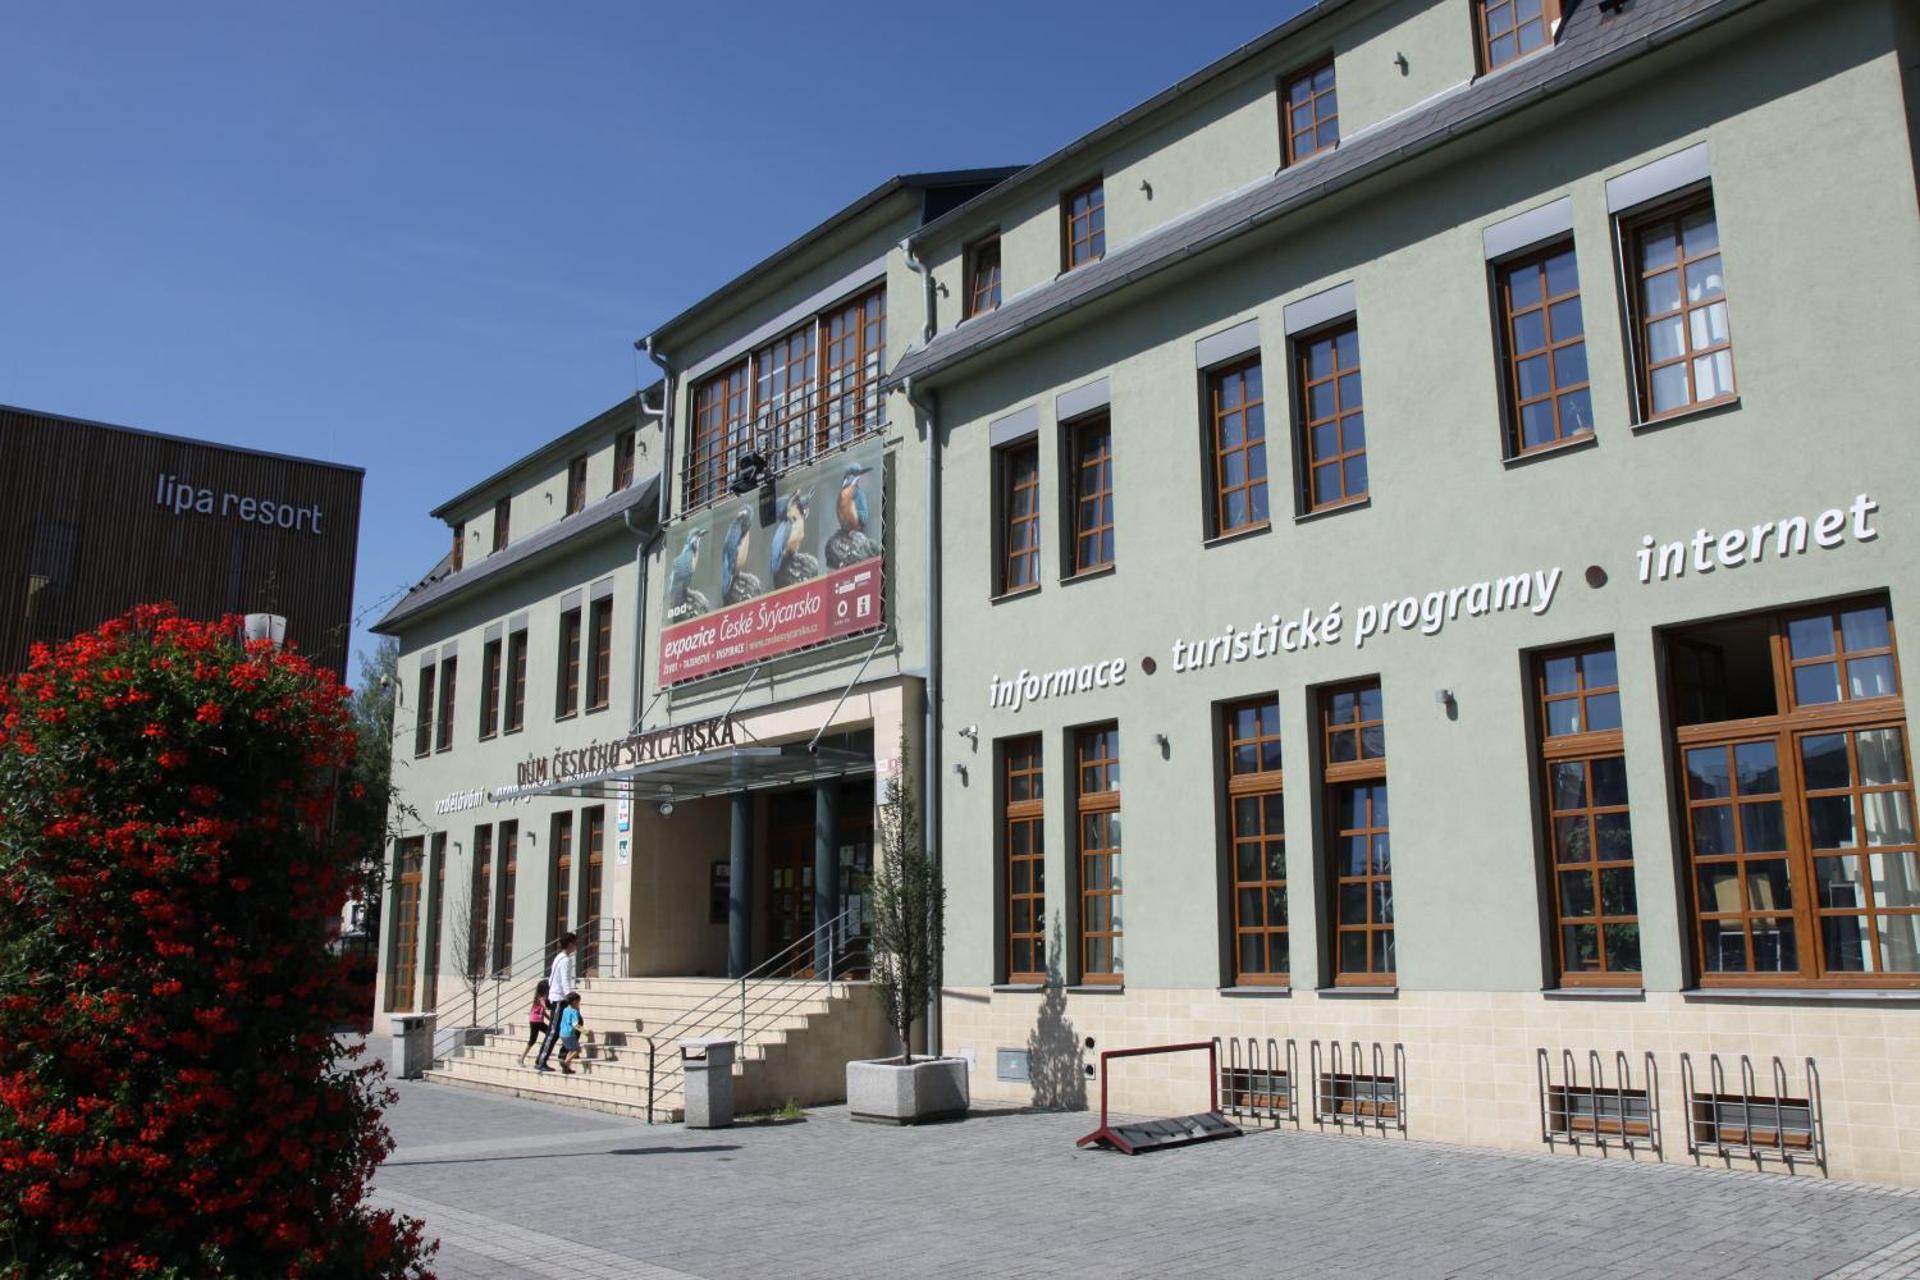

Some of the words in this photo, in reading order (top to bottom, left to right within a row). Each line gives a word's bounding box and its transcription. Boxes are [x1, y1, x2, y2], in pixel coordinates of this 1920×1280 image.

[156, 473, 214, 516] lípa
[222, 492, 323, 534] resort
[664, 625, 717, 660] expozice
[720, 612, 754, 642] České
[756, 591, 821, 633] Švýcarsko
[989, 655, 1127, 711] informace
[1172, 601, 1342, 673] turistické
[1354, 566, 1563, 647] programy
[1637, 492, 1878, 581] internet
[517, 751, 547, 786] DŮM
[552, 739, 622, 778] ČESKÉHO
[434, 785, 486, 815] vzdělávání
